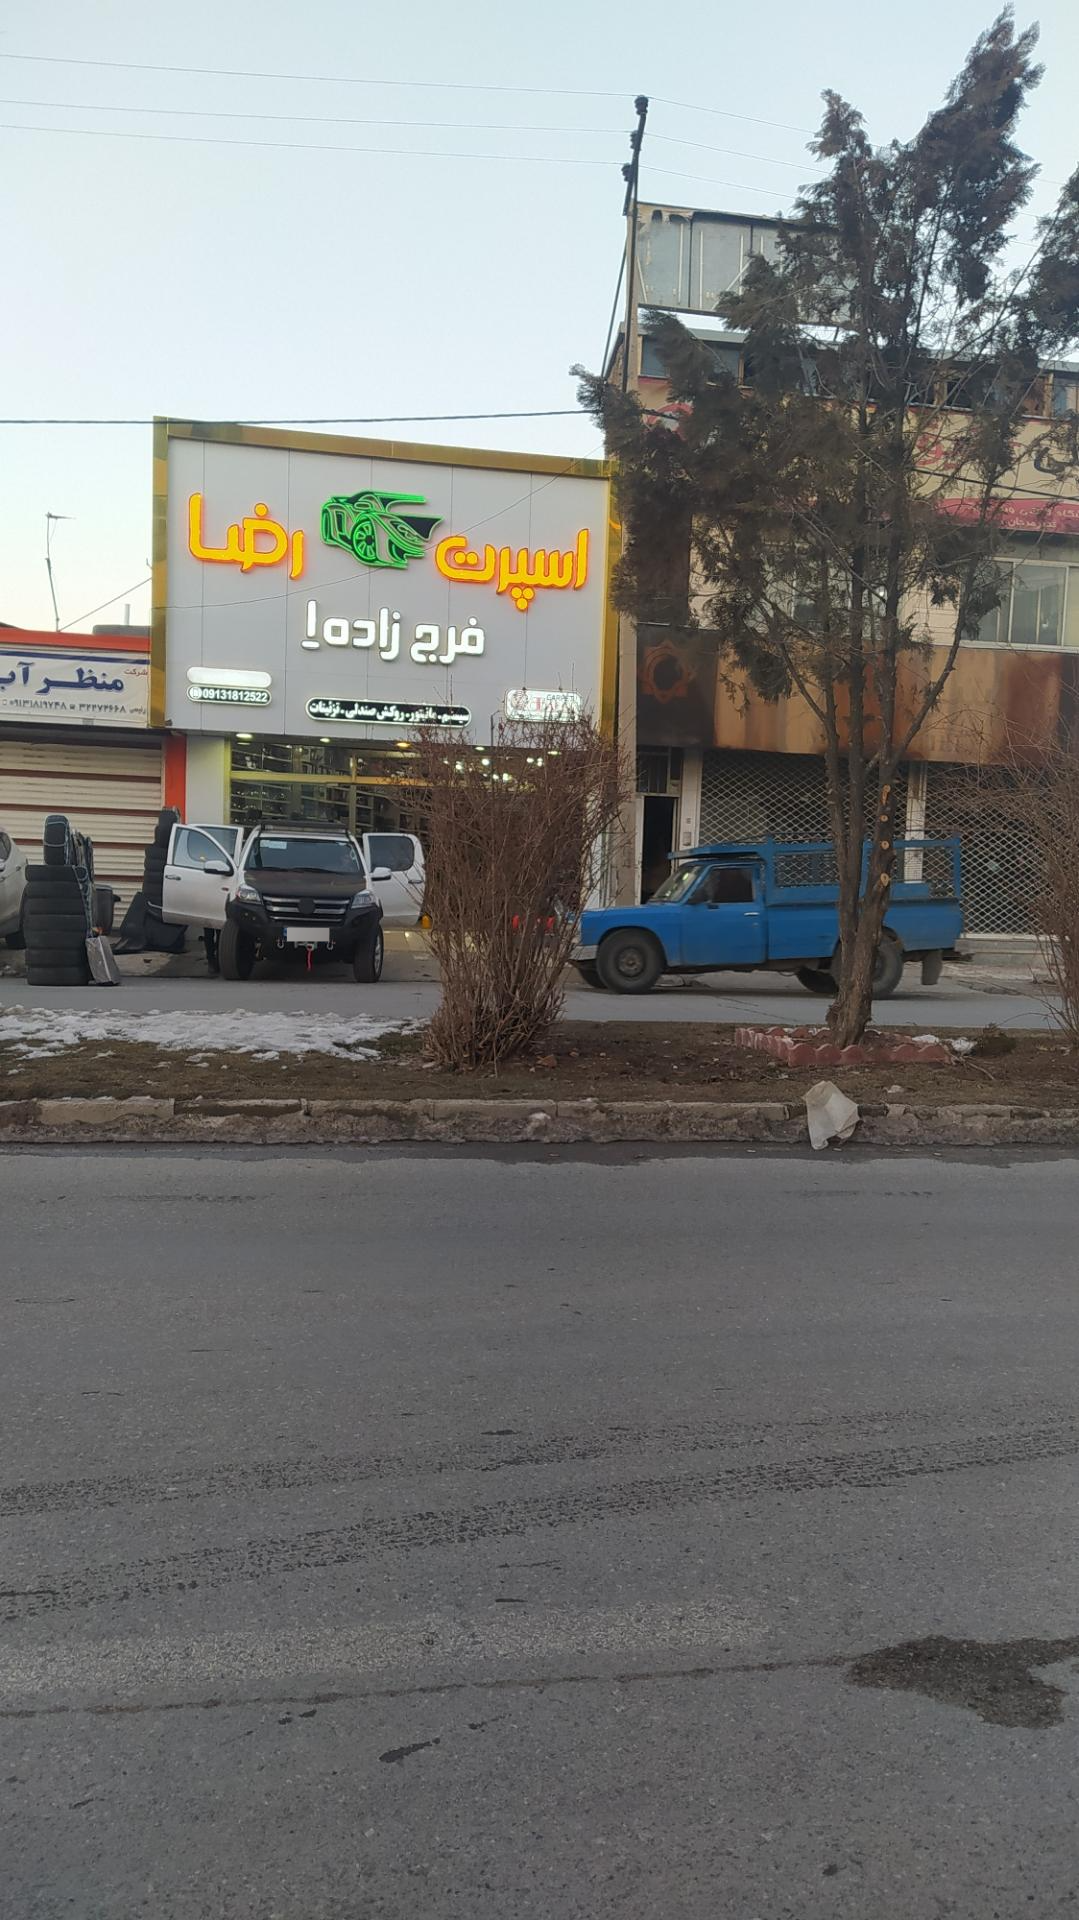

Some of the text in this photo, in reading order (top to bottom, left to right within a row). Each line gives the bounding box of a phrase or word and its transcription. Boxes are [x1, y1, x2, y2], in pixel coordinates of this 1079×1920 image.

[188, 492, 590, 612] اسپرت رضا
[410, 616, 485, 664] فرج
[36, 667, 124, 694] منظر
[202, 688, 268, 702] 09131812522
[309, 700, 341, 718] تزئینات
[345, 702, 377, 719] صندلی
[376, 704, 405, 721] روکش
